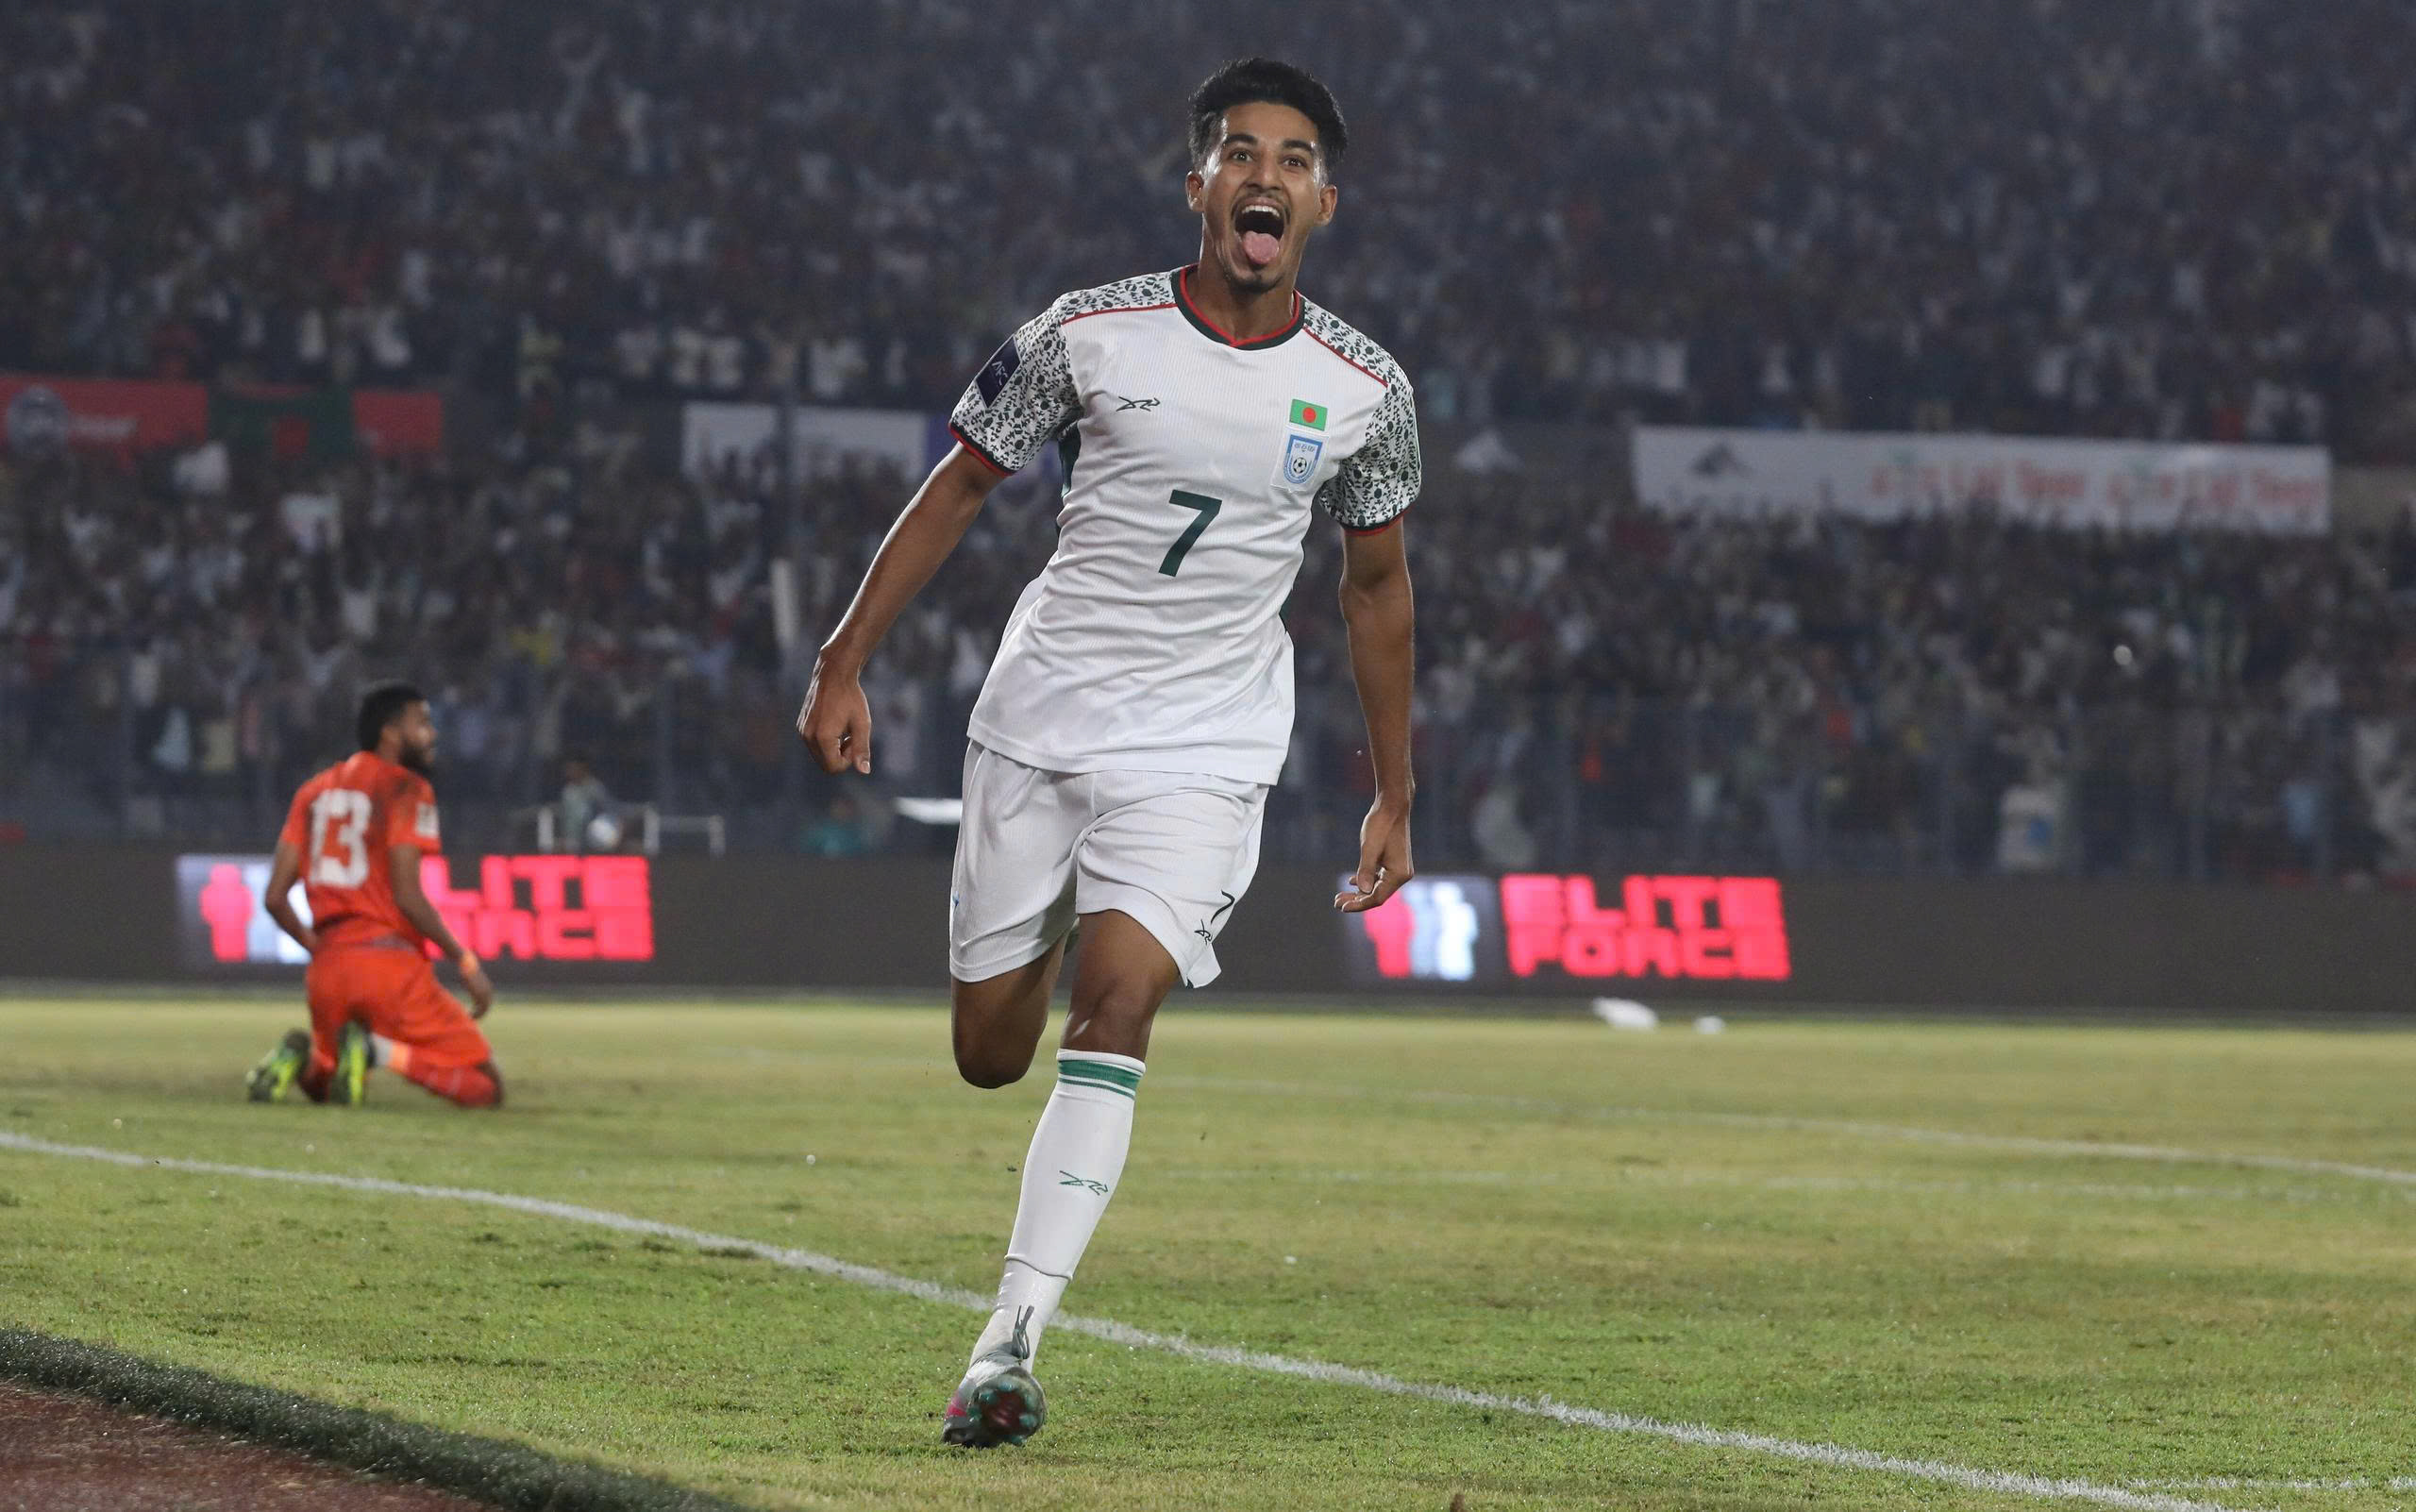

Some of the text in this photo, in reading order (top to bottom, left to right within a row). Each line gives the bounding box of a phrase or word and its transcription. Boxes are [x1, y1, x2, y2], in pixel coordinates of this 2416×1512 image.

[1158, 489, 1223, 578] 7
[308, 788, 374, 889] 13
[419, 853, 649, 909] LITE
